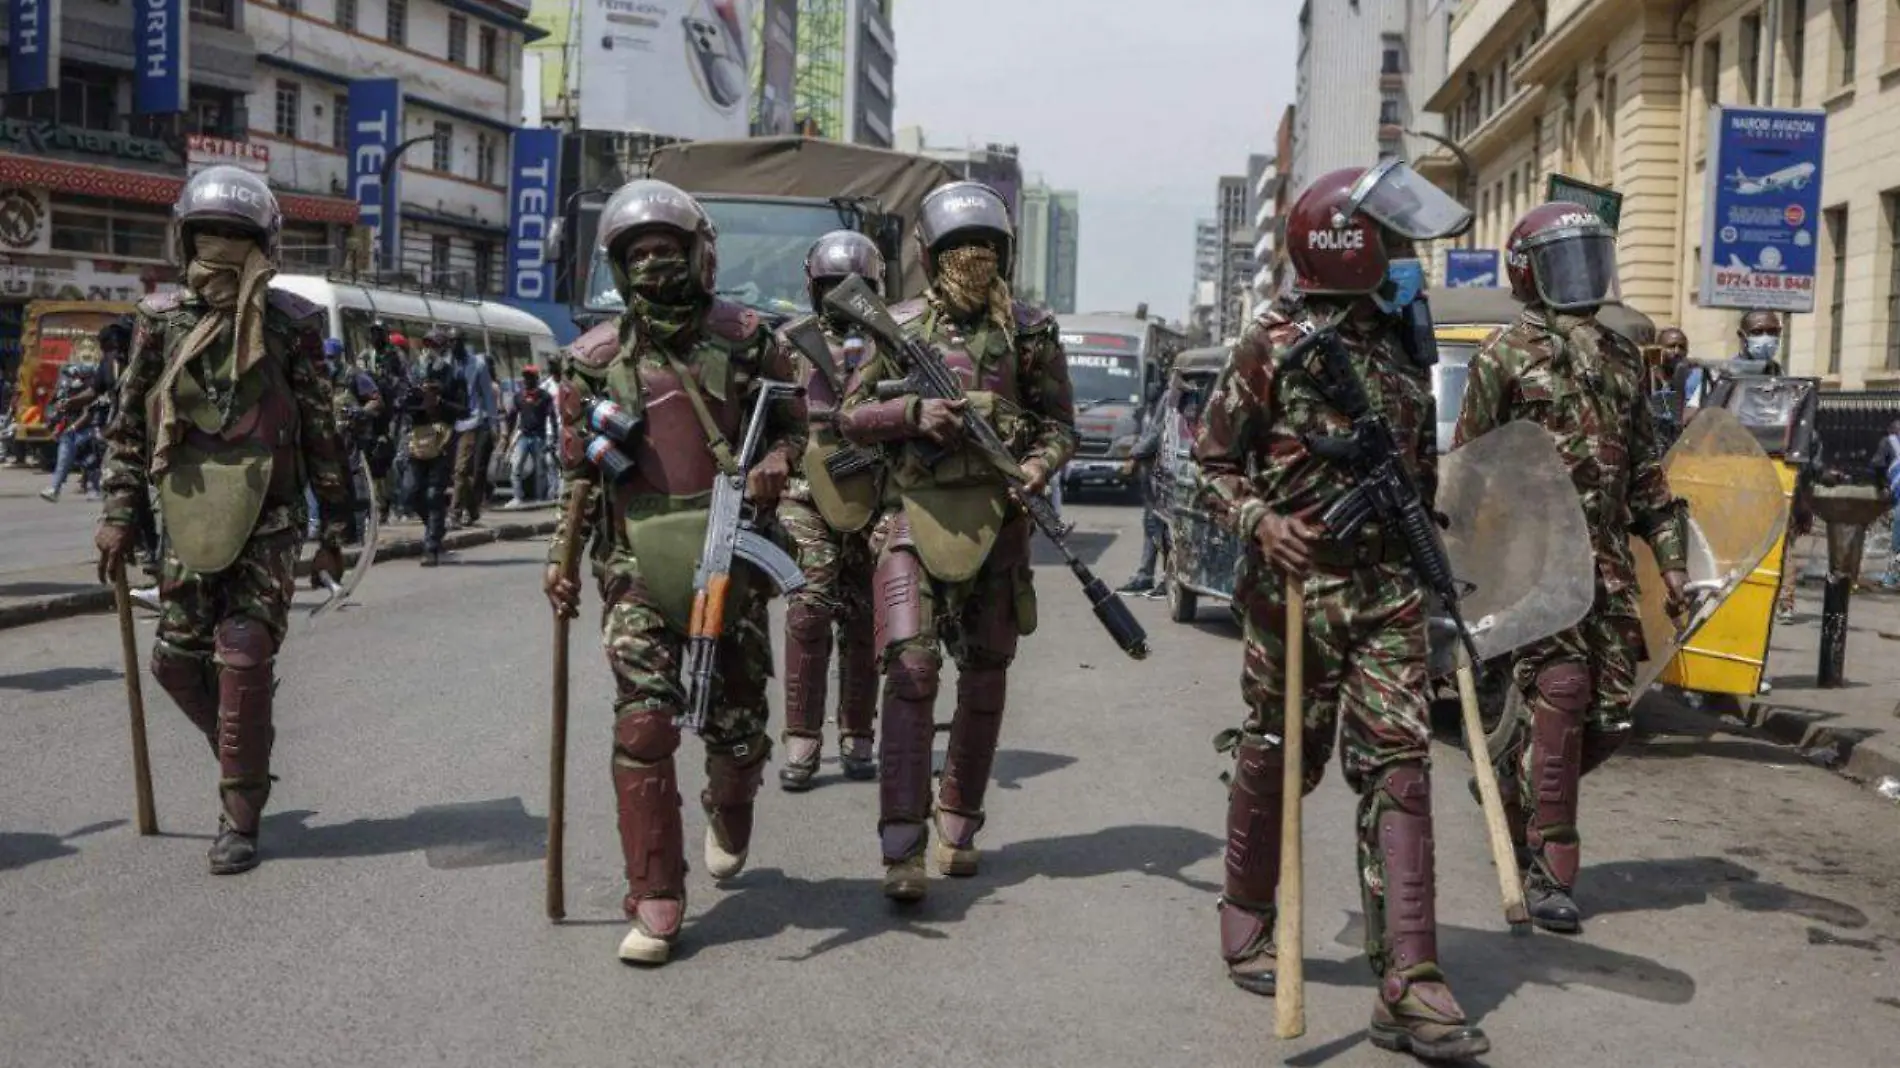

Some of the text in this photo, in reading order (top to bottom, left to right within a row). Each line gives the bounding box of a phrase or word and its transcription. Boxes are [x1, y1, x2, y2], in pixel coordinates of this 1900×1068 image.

[1731, 117, 1816, 133] NAIROBI AVIATION
[517, 158, 549, 298] TECNO
[1308, 229, 1365, 249] POLICE
